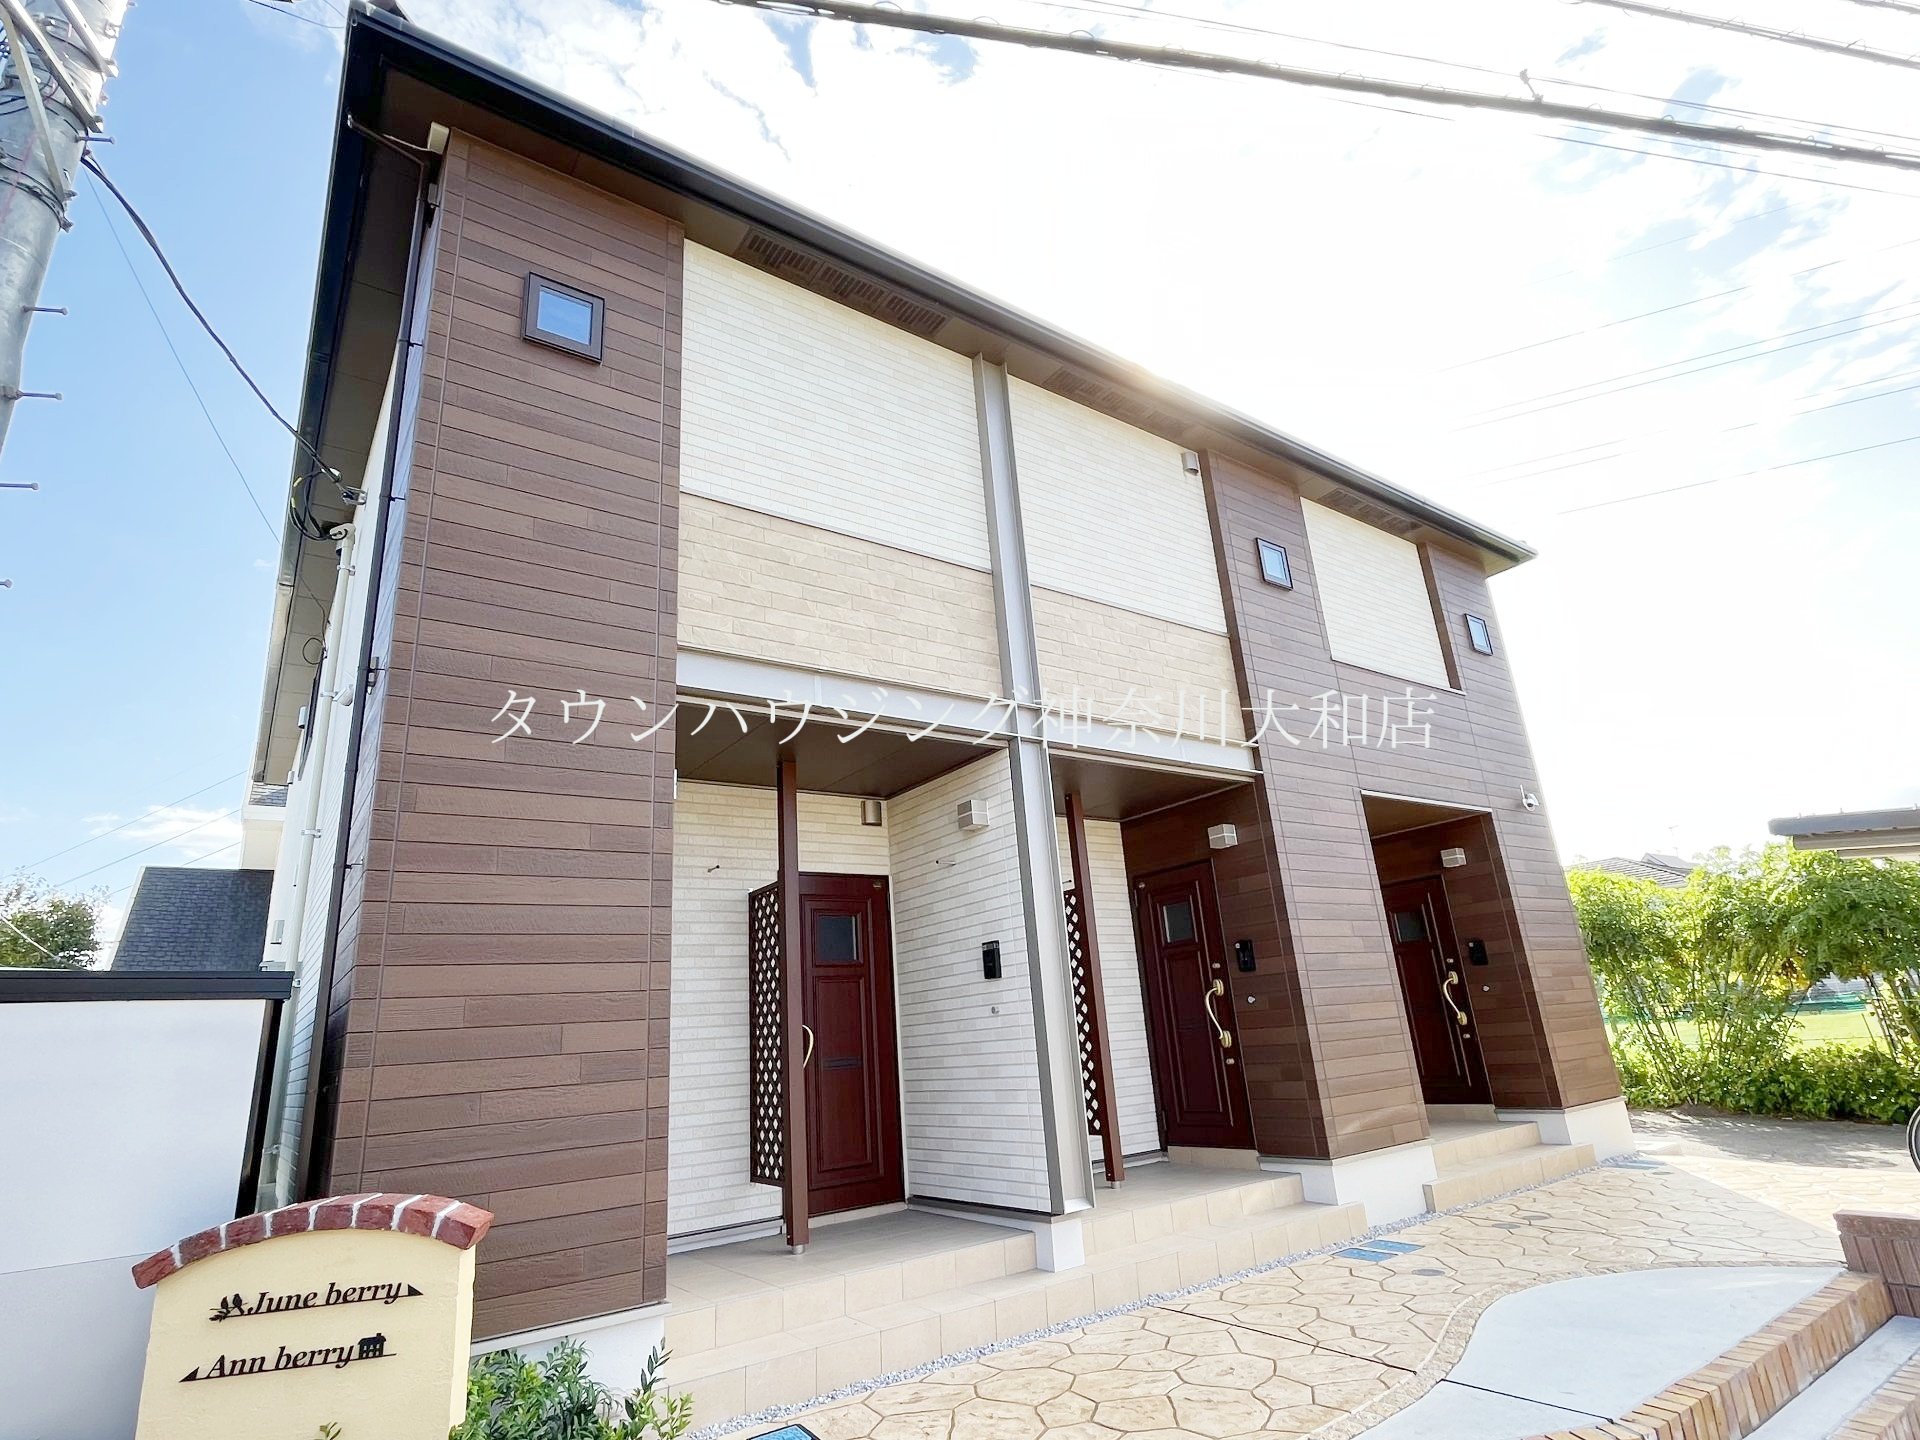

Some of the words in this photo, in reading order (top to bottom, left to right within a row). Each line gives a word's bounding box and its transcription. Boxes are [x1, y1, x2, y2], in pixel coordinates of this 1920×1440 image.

[247, 1291, 318, 1315] June
[325, 1282, 402, 1304] berry
[205, 1354, 267, 1379] Ann
[274, 1346, 354, 1370] berry
